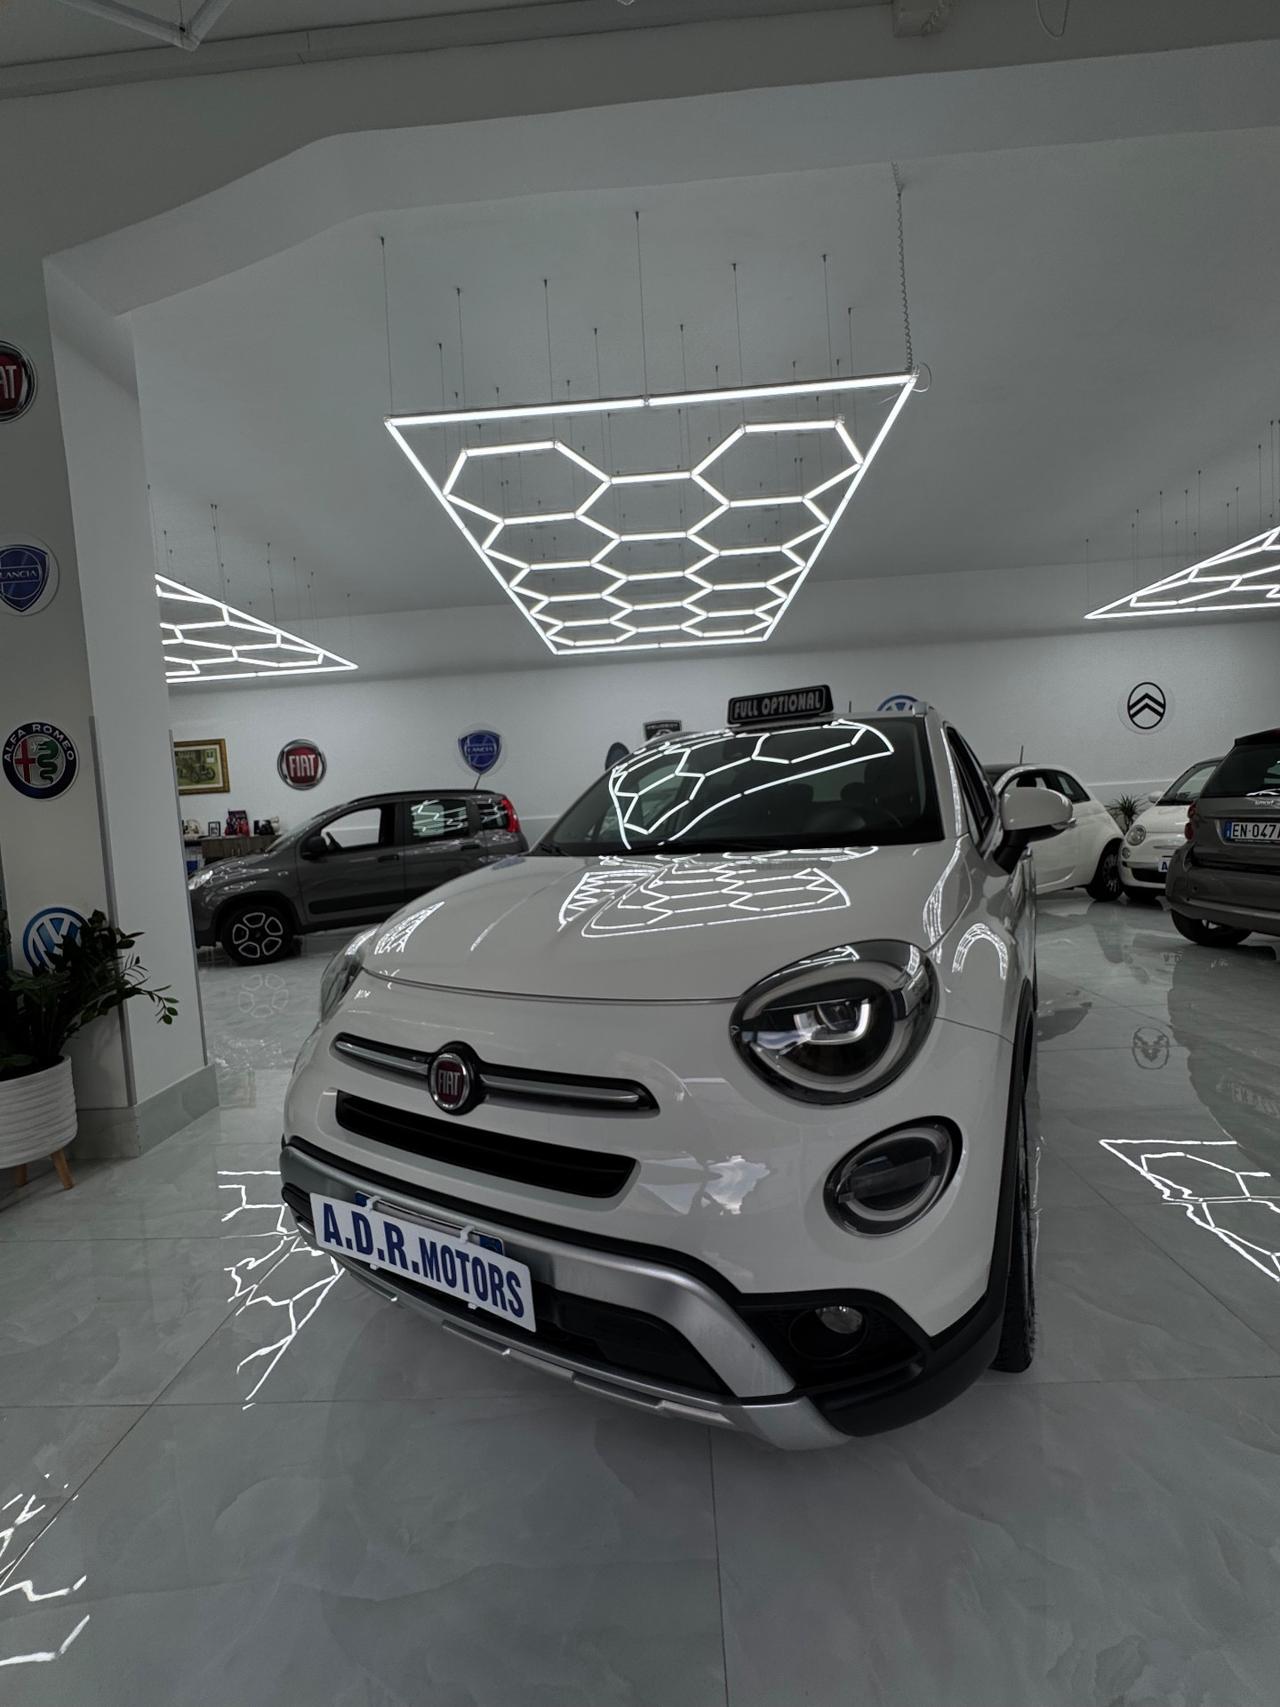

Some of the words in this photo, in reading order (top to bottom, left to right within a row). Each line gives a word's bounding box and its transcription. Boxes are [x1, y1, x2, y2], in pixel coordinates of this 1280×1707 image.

[734, 701, 759, 719] FULL
[761, 691, 821, 716] OPTIONAL
[4, 728, 27, 762] ALFA
[31, 723, 75, 761] ROMEO
[288, 754, 316, 778] FIAT
[1232, 823, 1248, 838] EN
[438, 1069, 461, 1096] FIAT
[322, 1202, 525, 1319] A.D.R.MOTORS
